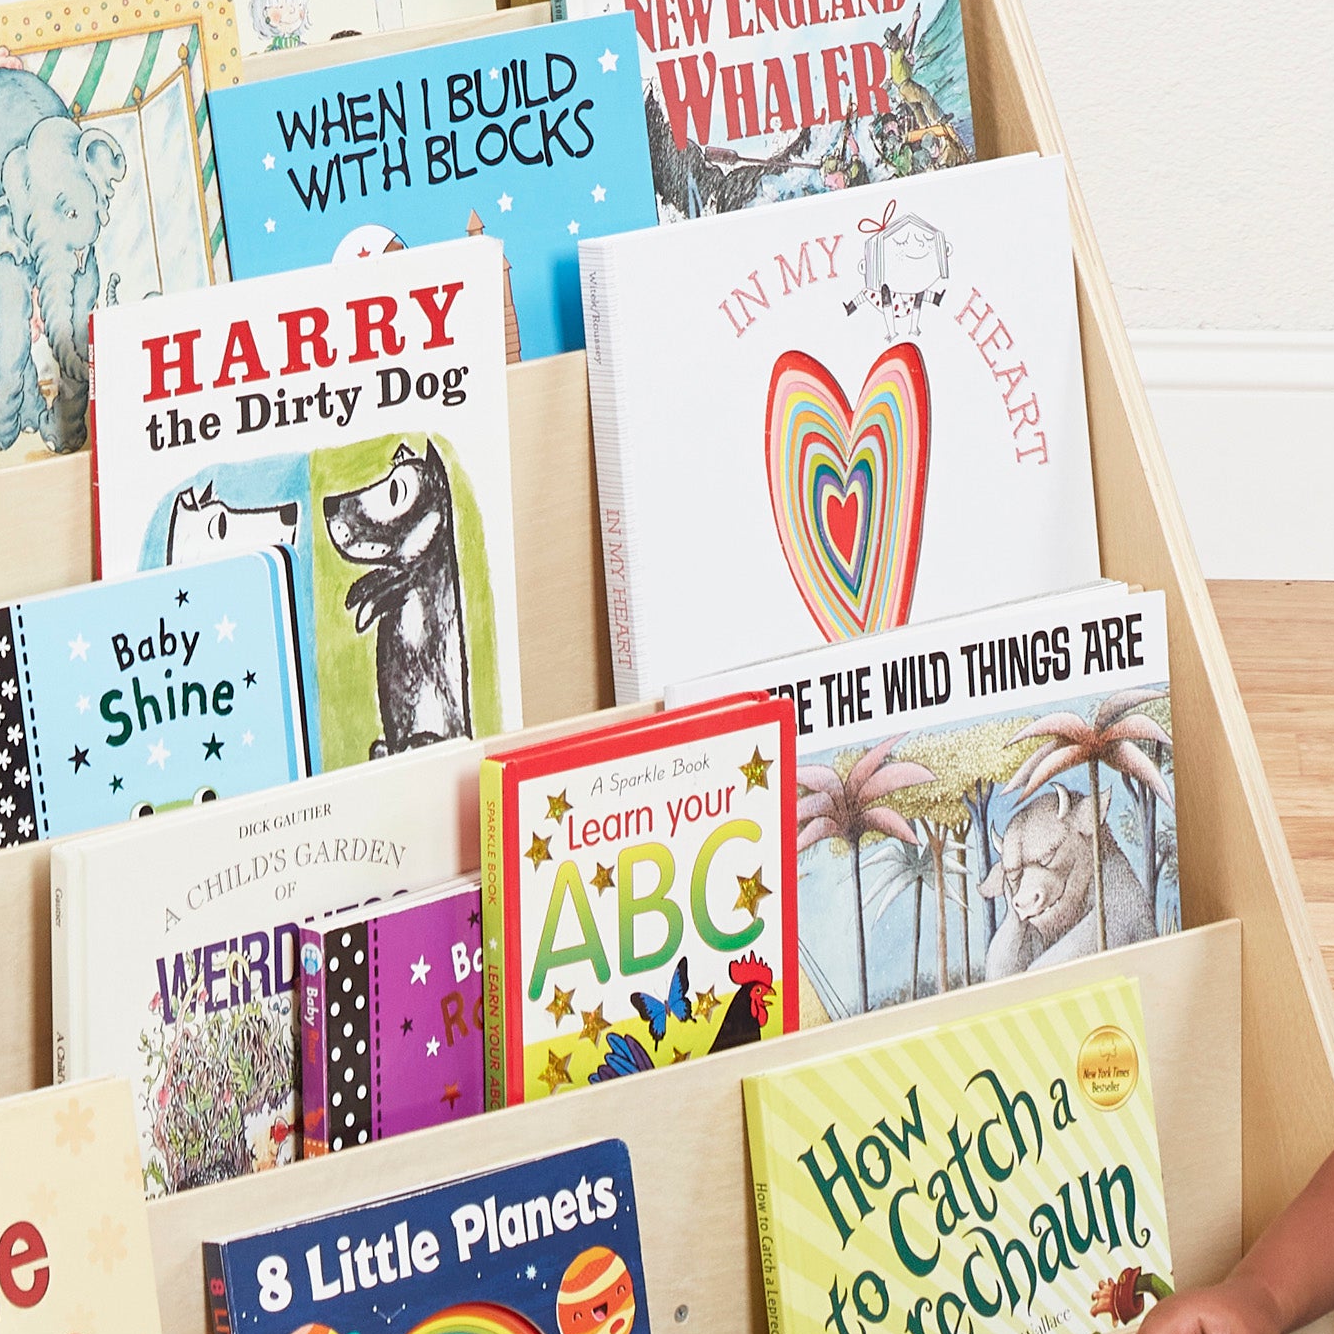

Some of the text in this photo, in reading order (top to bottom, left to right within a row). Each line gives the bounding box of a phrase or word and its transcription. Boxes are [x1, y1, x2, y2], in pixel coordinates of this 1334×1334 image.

[277, 52, 577, 152] WHEN I BUILD
[656, 40, 892, 152] WHALER
[287, 99, 595, 213] WITH BLOCKS
[717, 234, 845, 339] IN MY
[142, 282, 465, 402] HARRY
[952, 287, 1050, 467] HEART
[146, 366, 469, 452] the Dirty Dog
[605, 508, 632, 670] IN MY HEART
[111, 617, 200, 672] Baby
[820, 666, 873, 729] THE
[882, 650, 951, 716] WILD
[960, 625, 1072, 699] THINGS
[1081, 612, 1144, 675] ARE
[100, 668, 235, 748] Shine
[239, 803, 332, 840] DICK GAUTIER
[568, 785, 737, 852] Learn your
[591, 753, 711, 797] A Sparkle Book
[164, 837, 407, 933] A CHILD'S GARDEN
[275, 881, 298, 902] OF
[486, 800, 497, 907] SPARKLE BOOK
[528, 818, 766, 1003] ABC
[304, 986, 319, 1027] Baby
[488, 965, 500, 1064] LEARN YOUR
[756, 1182, 767, 1212] How
[797, 1083, 928, 1250] How
[889, 1069, 1044, 1277] Catch
[1050, 1078, 1076, 1131] a
[257, 1174, 617, 1313] 8 Little Planets
[760, 1217, 769, 1231] to
[761, 1237, 774, 1273] Catch
[210, 1276, 225, 1297] 8
